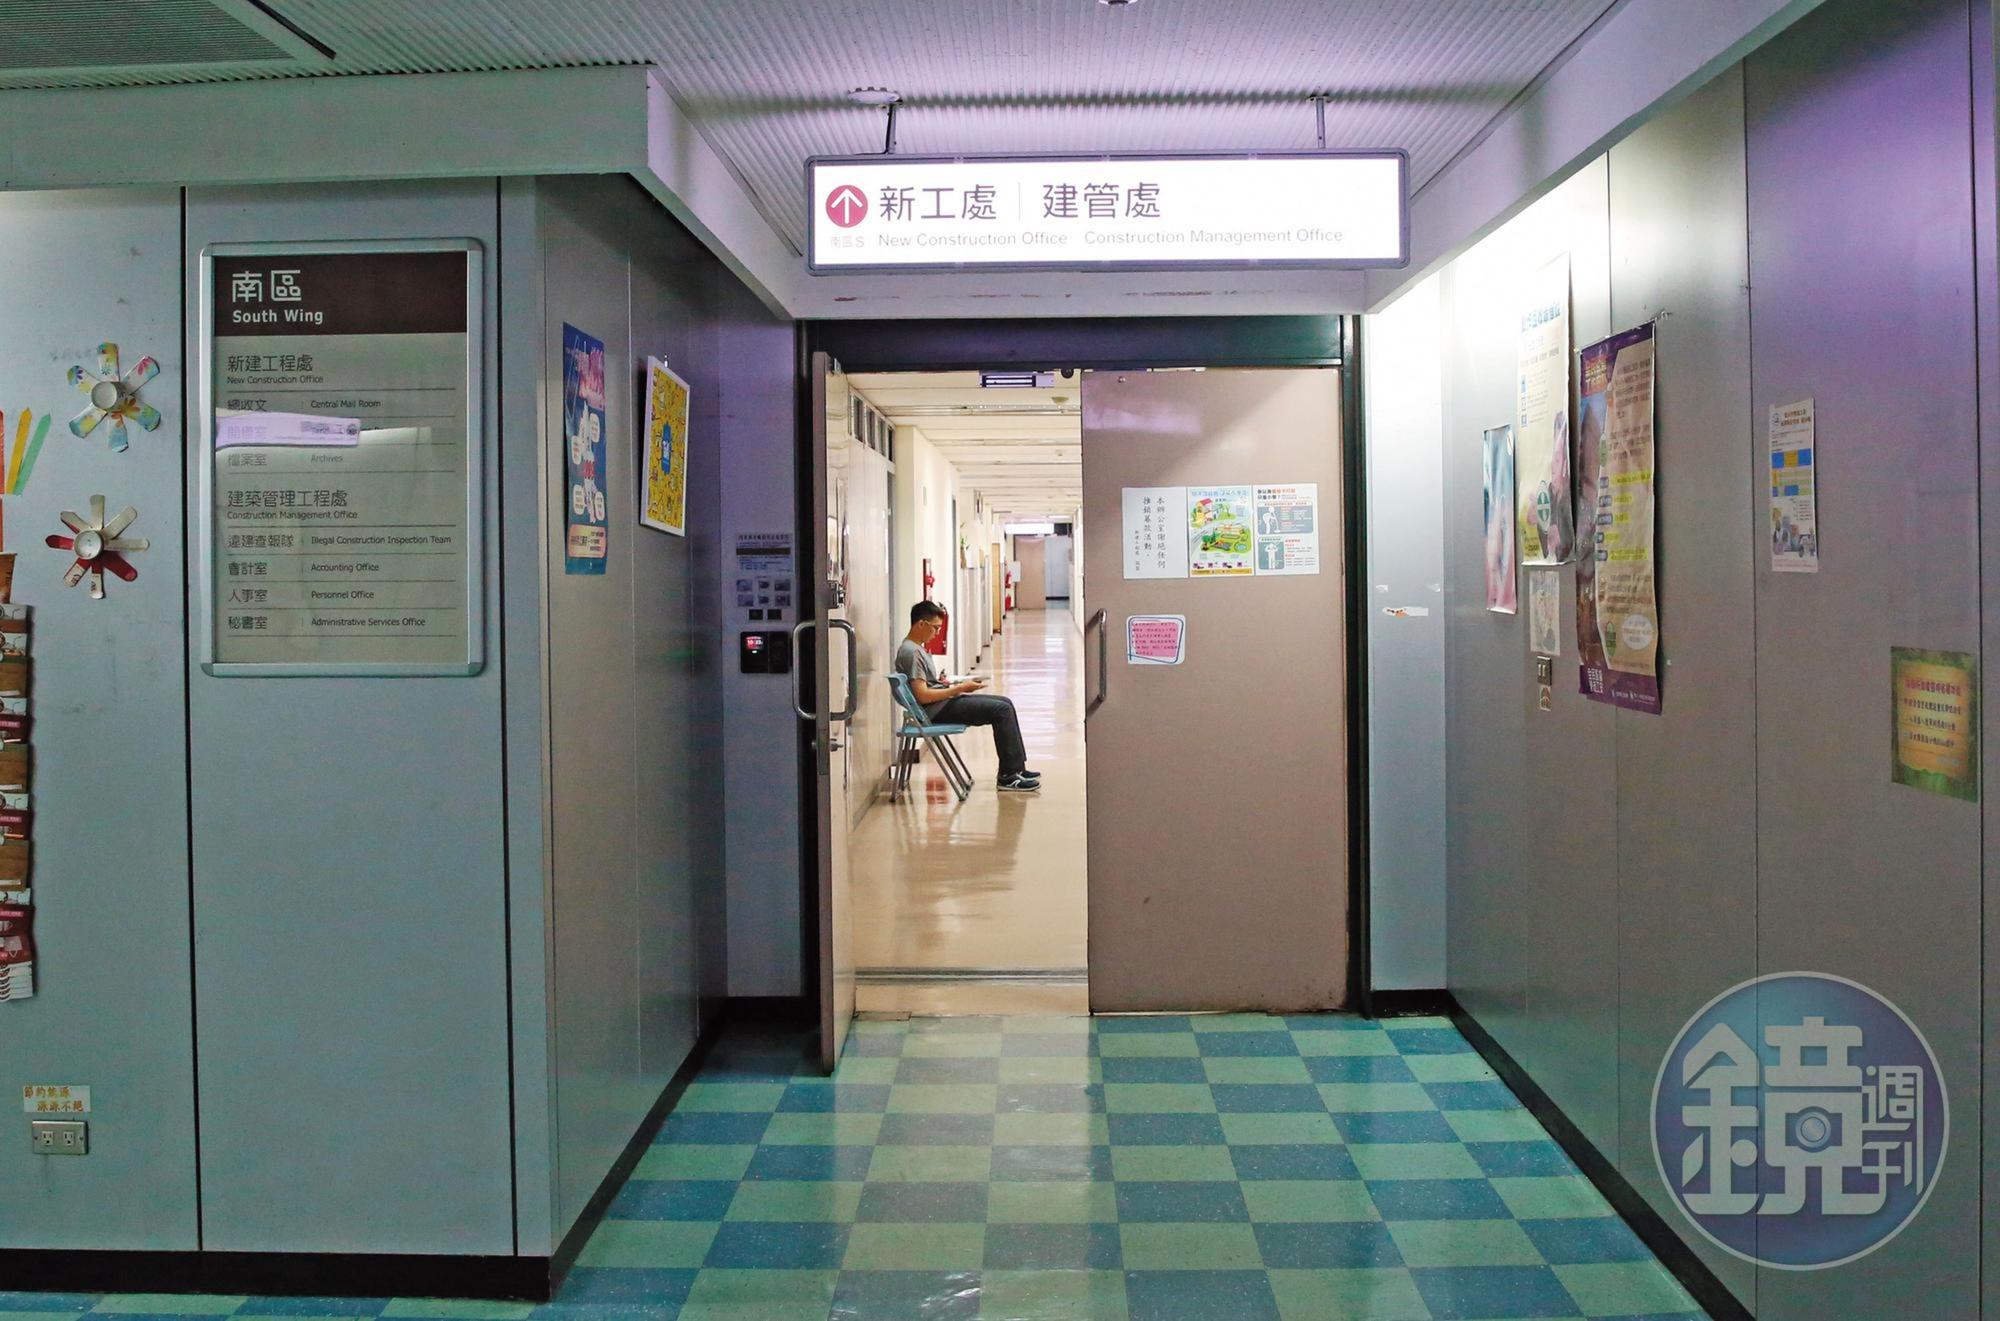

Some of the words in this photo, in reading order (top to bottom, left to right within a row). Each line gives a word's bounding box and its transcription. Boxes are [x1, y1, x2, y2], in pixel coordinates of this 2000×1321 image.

[879, 184, 997, 222] 新工處
[1042, 182, 1162, 219] 建管處
[879, 234, 912, 247] New
[917, 231, 1017, 246] Construction
[1021, 231, 1068, 246] Office
[1084, 230, 1185, 245] Construction
[1189, 228, 1293, 245] Management
[1296, 228, 1344, 243] Office
[232, 270, 302, 302] 南區
[232, 310, 278, 324] South
[284, 309, 324, 325] Wing
[227, 354, 313, 372] 新建工程處
[227, 376, 245, 384] New
[247, 375, 297, 384] Construction
[300, 375, 324, 384] Office
[311, 400, 338, 408] Central
[359, 399, 381, 408] Room
[311, 454, 343, 463] Archives
[227, 490, 348, 507] 建築管理工程處
[227, 511, 277, 519] Construction
[279, 511, 331, 521] Management
[333, 510, 358, 519] Office
[227, 535, 294, 548] 違建查報隊
[311, 535, 335, 545] Illegal
[337, 535, 386, 544] Construction
[388, 535, 428, 545] Inspection
[430, 535, 451, 544] Team
[228, 562, 267, 576] 會計室
[311, 563, 353, 573] Accounting
[356, 563, 379, 572] Office
[228, 589, 267, 603] 人事室
[311, 591, 349, 599] Personnel
[351, 590, 374, 599] Office
[228, 615, 267, 629] 秘書室
[311, 617, 366, 626] Administrative
[368, 617, 400, 626] Services
[401, 617, 426, 626] Office
